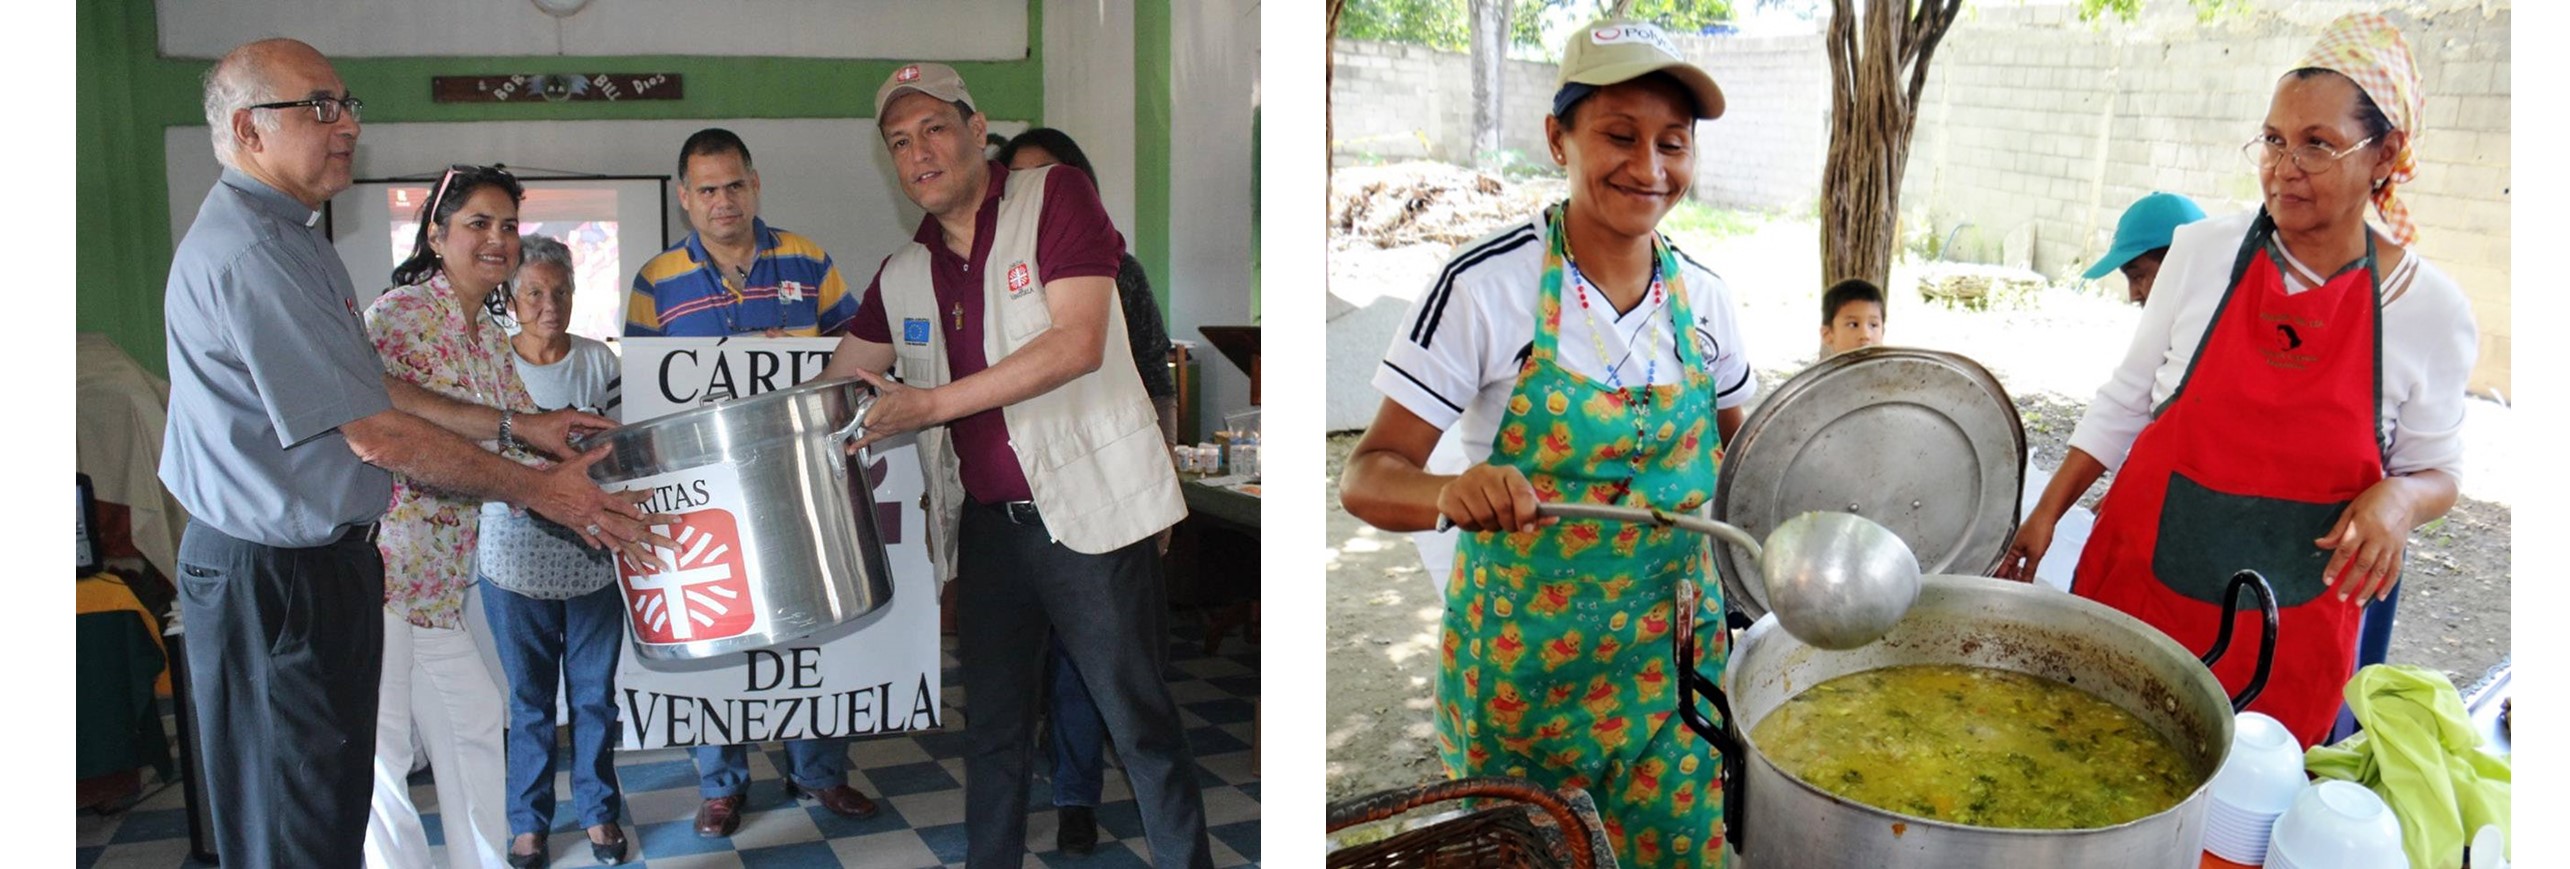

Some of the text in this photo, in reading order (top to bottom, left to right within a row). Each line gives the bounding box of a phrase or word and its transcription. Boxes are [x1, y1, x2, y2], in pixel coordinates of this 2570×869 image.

[593, 73, 621, 101] BILL
[743, 647, 824, 692] DE
[623, 672, 945, 749] VENEZUELA
